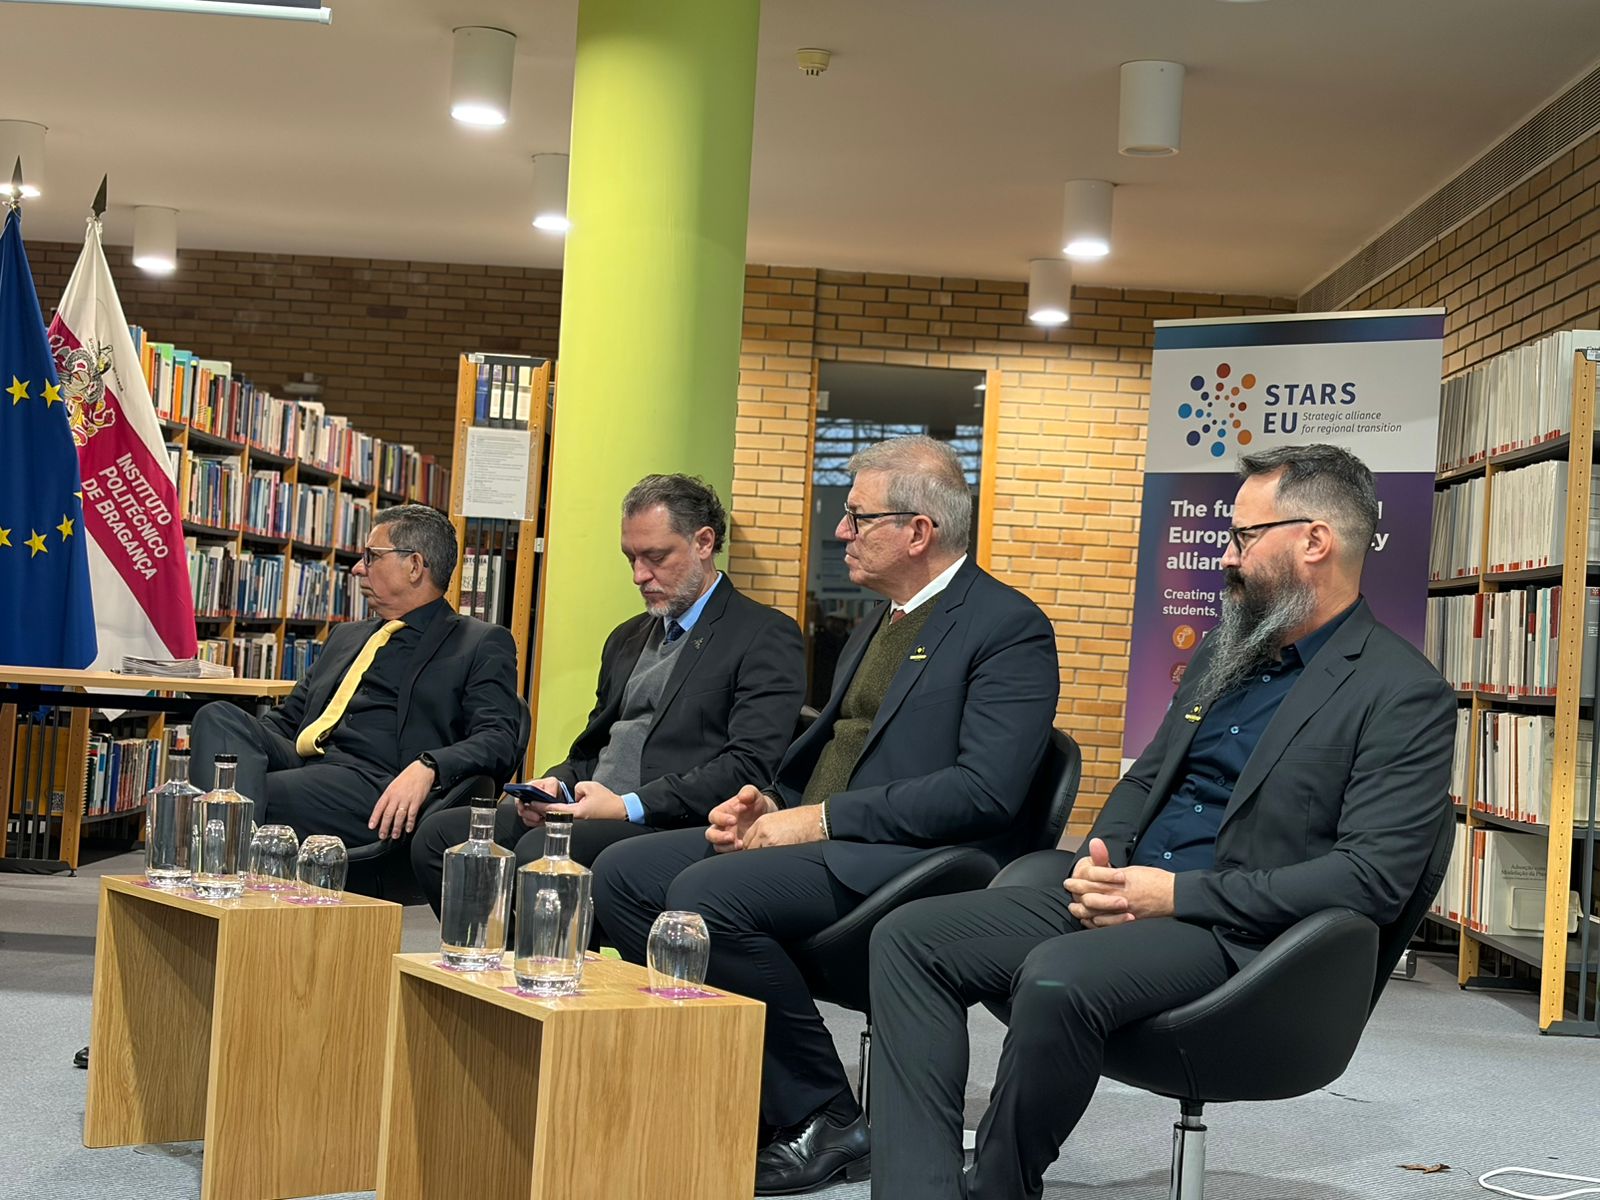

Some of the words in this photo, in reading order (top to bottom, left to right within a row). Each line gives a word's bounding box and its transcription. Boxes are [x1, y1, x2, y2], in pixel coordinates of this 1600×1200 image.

[1264, 382, 1356, 406] STARS
[1263, 412, 1298, 434] EU
[1302, 411, 1343, 423] Strategic
[1345, 411, 1382, 421] alliance
[1301, 424, 1315, 436] for
[1316, 423, 1355, 436] regional
[1357, 422, 1402, 433] transition
[116, 452, 172, 525] INSTITUTO
[98, 465, 169, 559] POLITÉCNICO
[1170, 500, 1208, 518] The
[81, 478, 105, 501] DE
[95, 499, 158, 580] BRAGANÇA
[1163, 589, 1216, 603] Creating
[1162, 604, 1219, 618] students,
